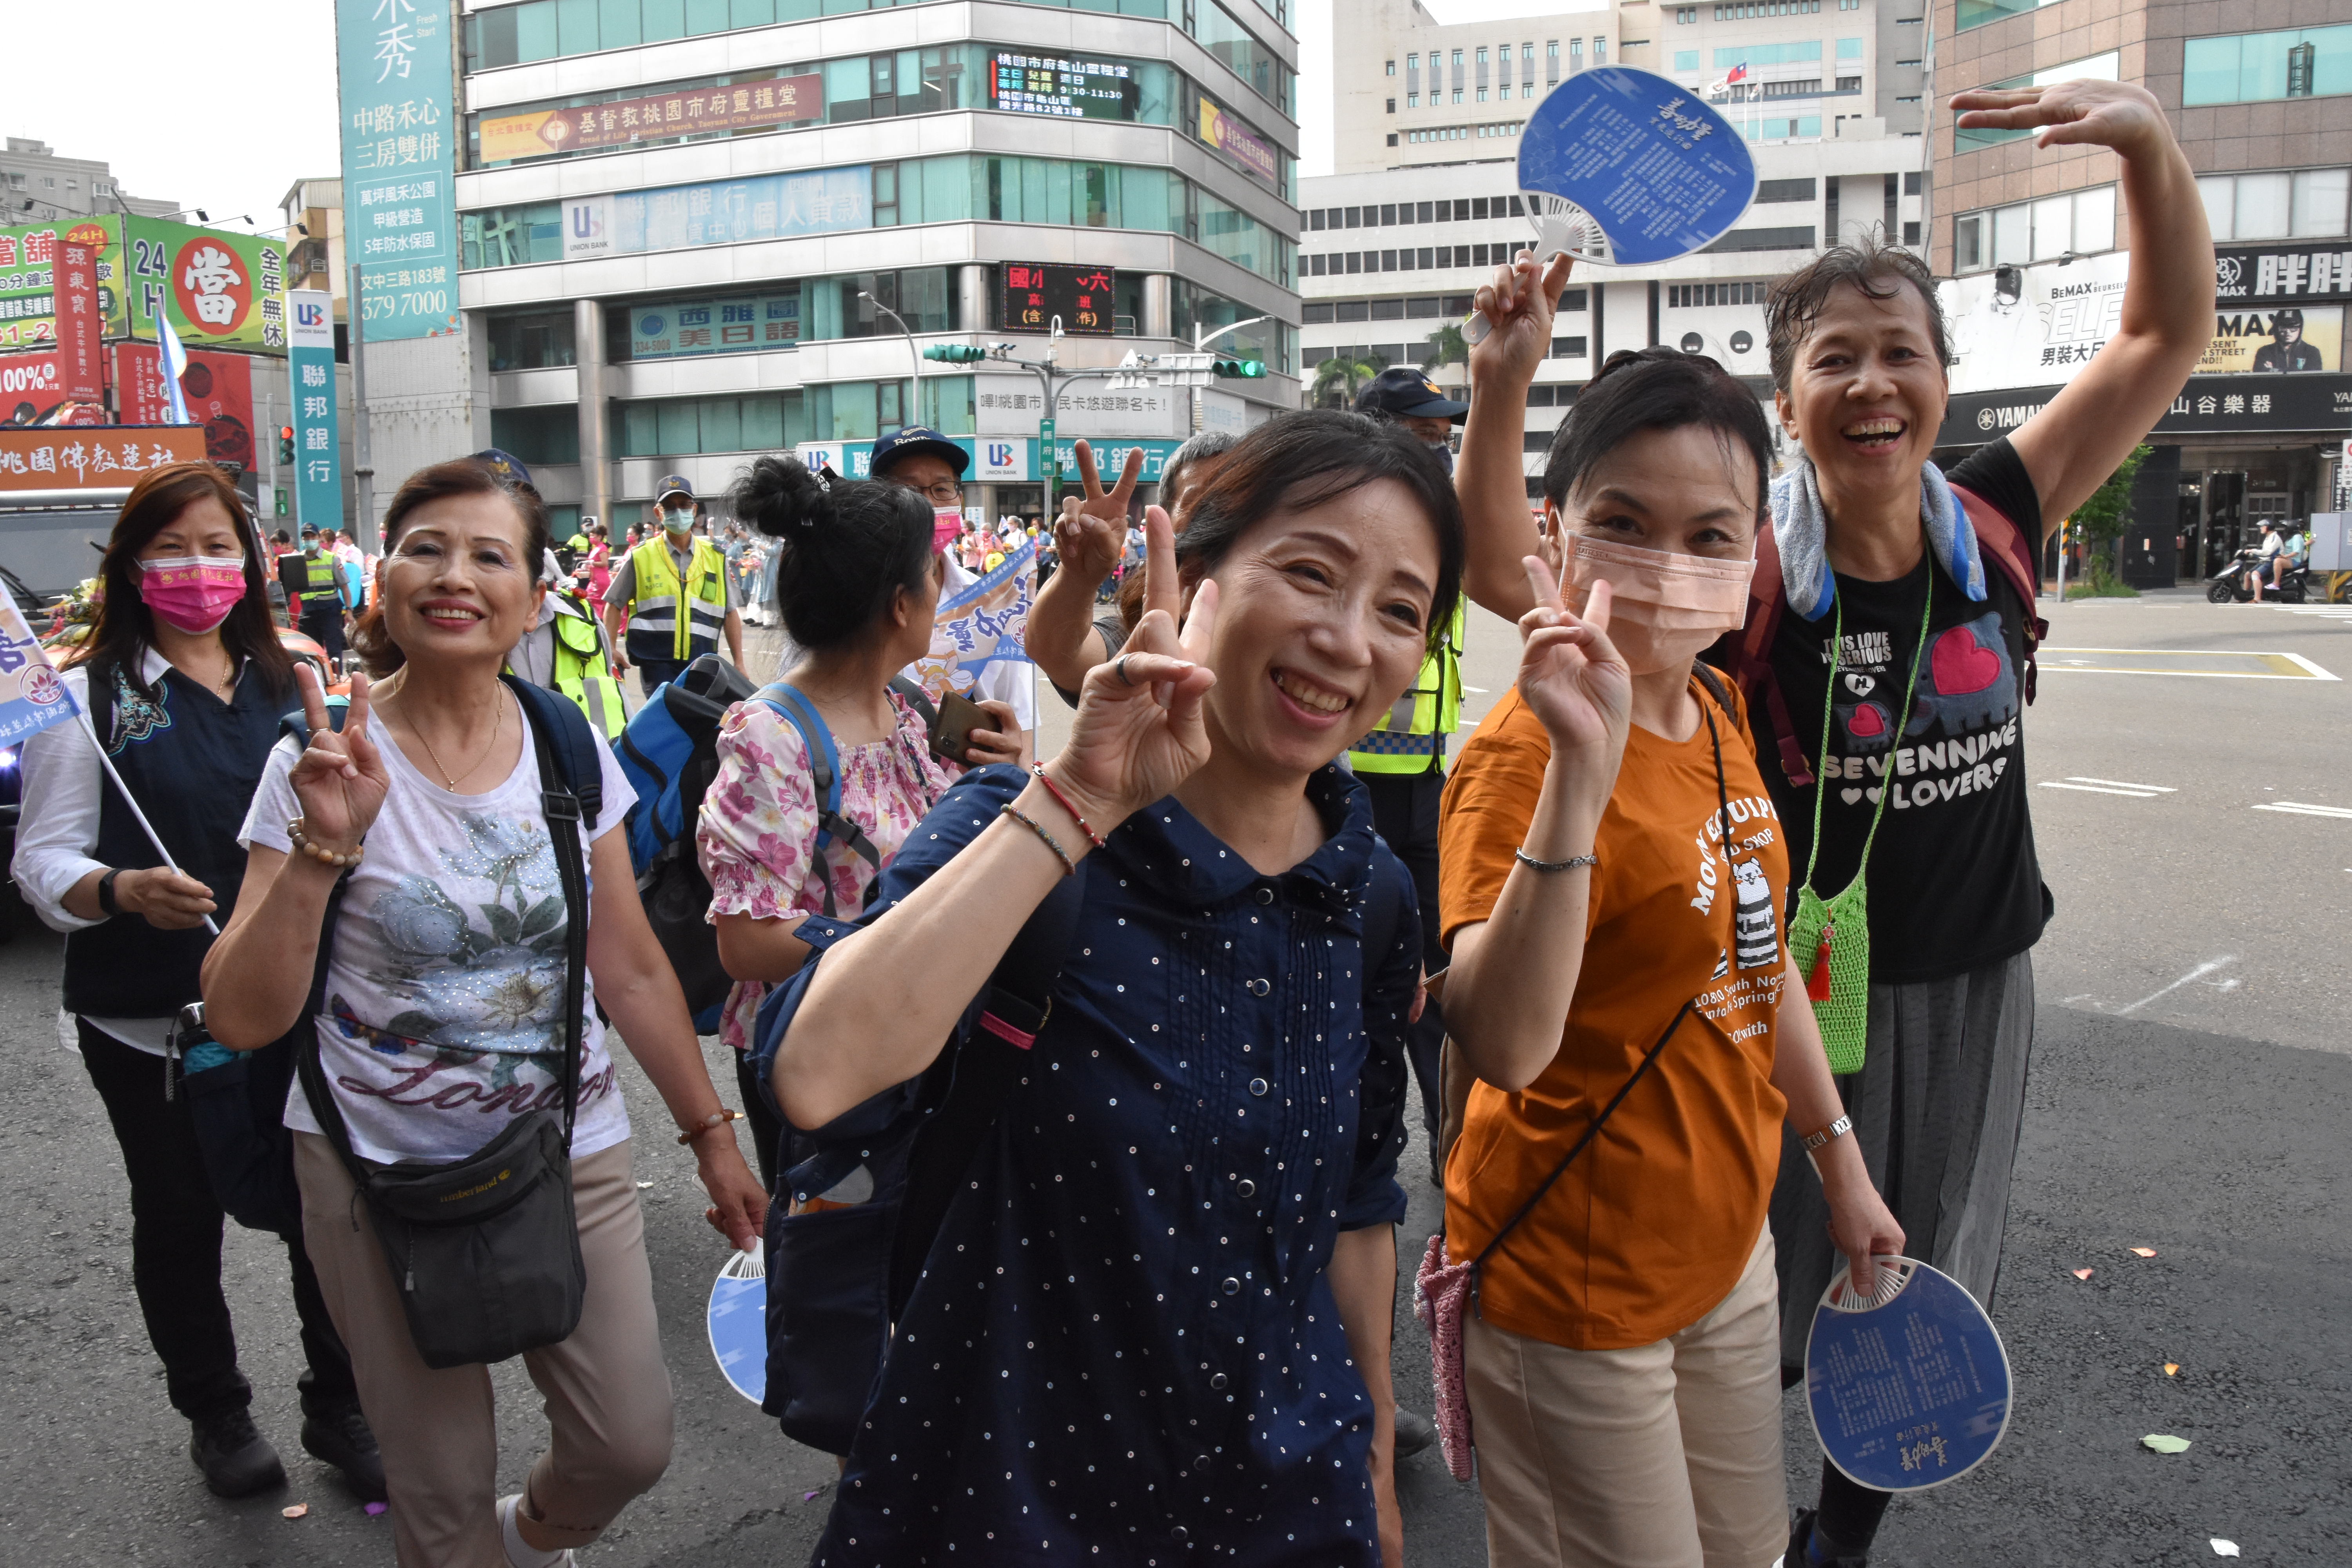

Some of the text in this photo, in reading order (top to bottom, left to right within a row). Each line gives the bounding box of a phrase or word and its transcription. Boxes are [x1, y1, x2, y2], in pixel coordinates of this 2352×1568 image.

[416, 13, 437, 24] Fresh
[417, 27, 436, 38] Start
[998, 67, 1023, 78] 主日
[1028, 70, 1052, 81] 兒童
[1060, 86, 1122, 98] 9:30-11:30
[354, 98, 441, 136] 中路禾心
[579, 84, 797, 133] 基督教桃園市府靈糧堂
[613, 131, 626, 139] Life
[631, 127, 663, 136] Christian
[732, 115, 747, 125] City
[750, 109, 796, 122] Government
[355, 131, 441, 170] 三房雙併
[360, 181, 436, 207] 萬坪風禾公園
[373, 208, 424, 229] 甲級營造
[753, 194, 863, 231] 個人貸款
[69, 230, 103, 242] 24H
[365, 231, 435, 255] 5年防水保固
[570, 241, 609, 251] UNION BANK
[134, 239, 167, 277] 24
[66, 247, 90, 314] 孫東寶
[184, 247, 241, 325] 當
[360, 265, 446, 291] 文中三路183號
[260, 247, 284, 347] 全年無休
[2216, 286, 2247, 297] MAX
[362, 289, 447, 321] 379 7000
[678, 299, 799, 327] 西雅圖
[679, 321, 799, 347] 美日語
[2209, 348, 2246, 356] STREET
[0, 365, 45, 392] 00%
[980, 393, 1166, 412] 嗶!桃園市民卡悠遊聯名卡!
[2171, 394, 2271, 415] 山谷樂器
[302, 365, 330, 483] 聯邦銀行
[1042, 430, 1053, 471] 縣府路
[1823, 632, 1889, 653] THIS LOVE
[1837, 646, 1892, 666] SERIOUS
[1866, 665, 1886, 673] LOVERS
[1893, 757, 2007, 809] LOVERS
[1743, 828, 1774, 851] SHOP
[1724, 978, 1749, 997] South
[1740, 1021, 1768, 1039] with
